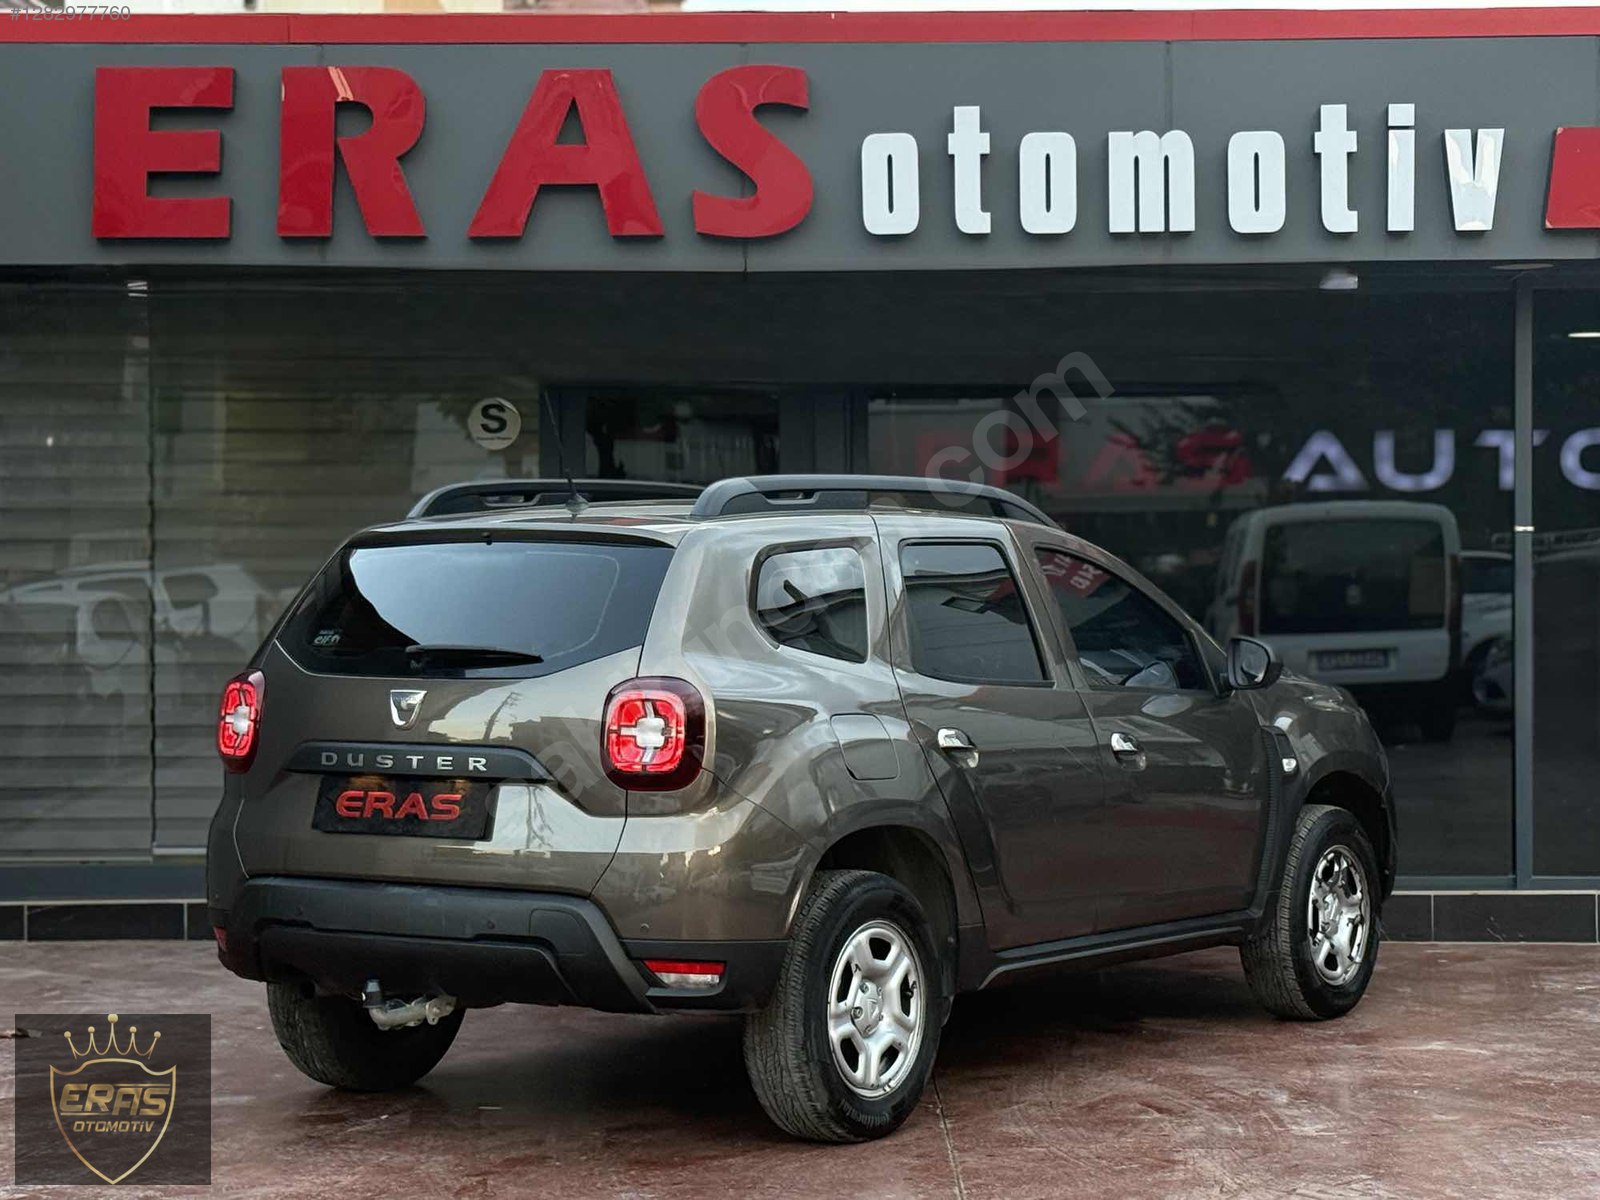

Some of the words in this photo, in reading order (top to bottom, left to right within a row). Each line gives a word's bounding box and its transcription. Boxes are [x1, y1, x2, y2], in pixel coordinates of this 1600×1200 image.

[92, 65, 814, 240] ERAS
[861, 103, 1505, 236] otomotiv
[480, 403, 507, 434] S
[320, 751, 487, 772] DUSTER
[335, 789, 463, 821] ERAS
